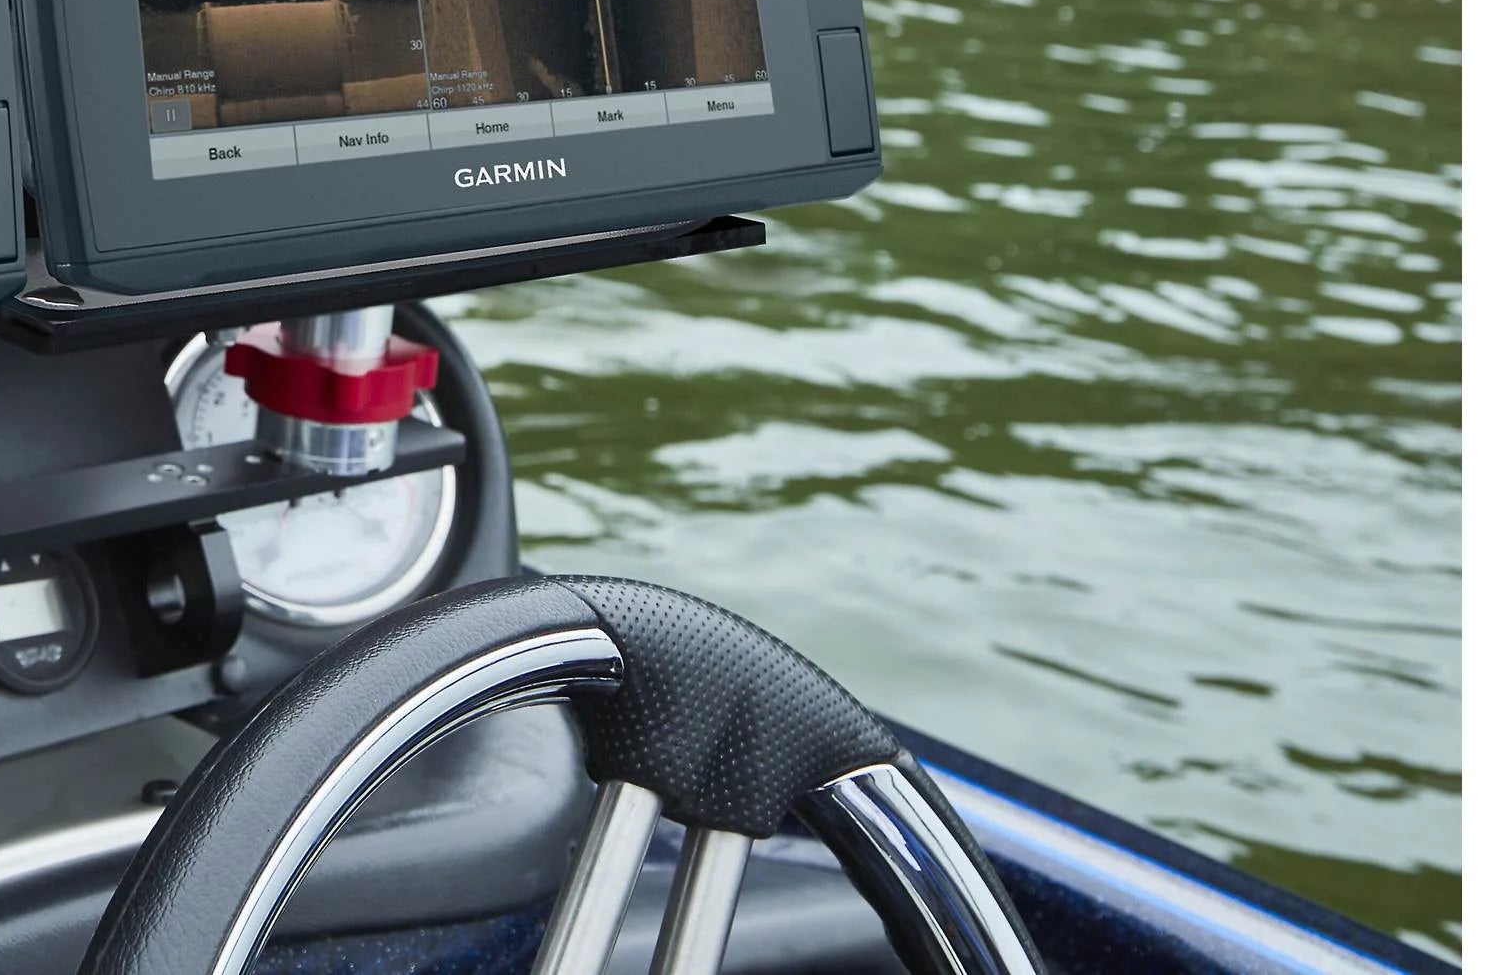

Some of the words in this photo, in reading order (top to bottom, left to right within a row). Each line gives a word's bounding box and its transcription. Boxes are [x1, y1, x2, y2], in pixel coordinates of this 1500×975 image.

[410, 39, 422, 51] 30
[148, 71, 182, 82] Manual
[184, 69, 215, 80] Range
[430, 72, 460, 81] Manual
[755, 69, 768, 81] 60
[644, 80, 657, 91] 15
[684, 77, 696, 87] 30
[148, 87, 175, 97] Chirp
[198, 83, 216, 93] kHz
[560, 87, 573, 99] 15
[472, 95, 485, 105] 45
[516, 91, 530, 102] 30
[432, 97, 448, 109] 60
[707, 99, 735, 113] Menu
[597, 109, 624, 123] Mark
[475, 121, 510, 135] Home
[338, 135, 363, 148] Nav
[366, 131, 390, 145] Info
[208, 145, 242, 161] Back
[454, 157, 567, 189] GARMIN
